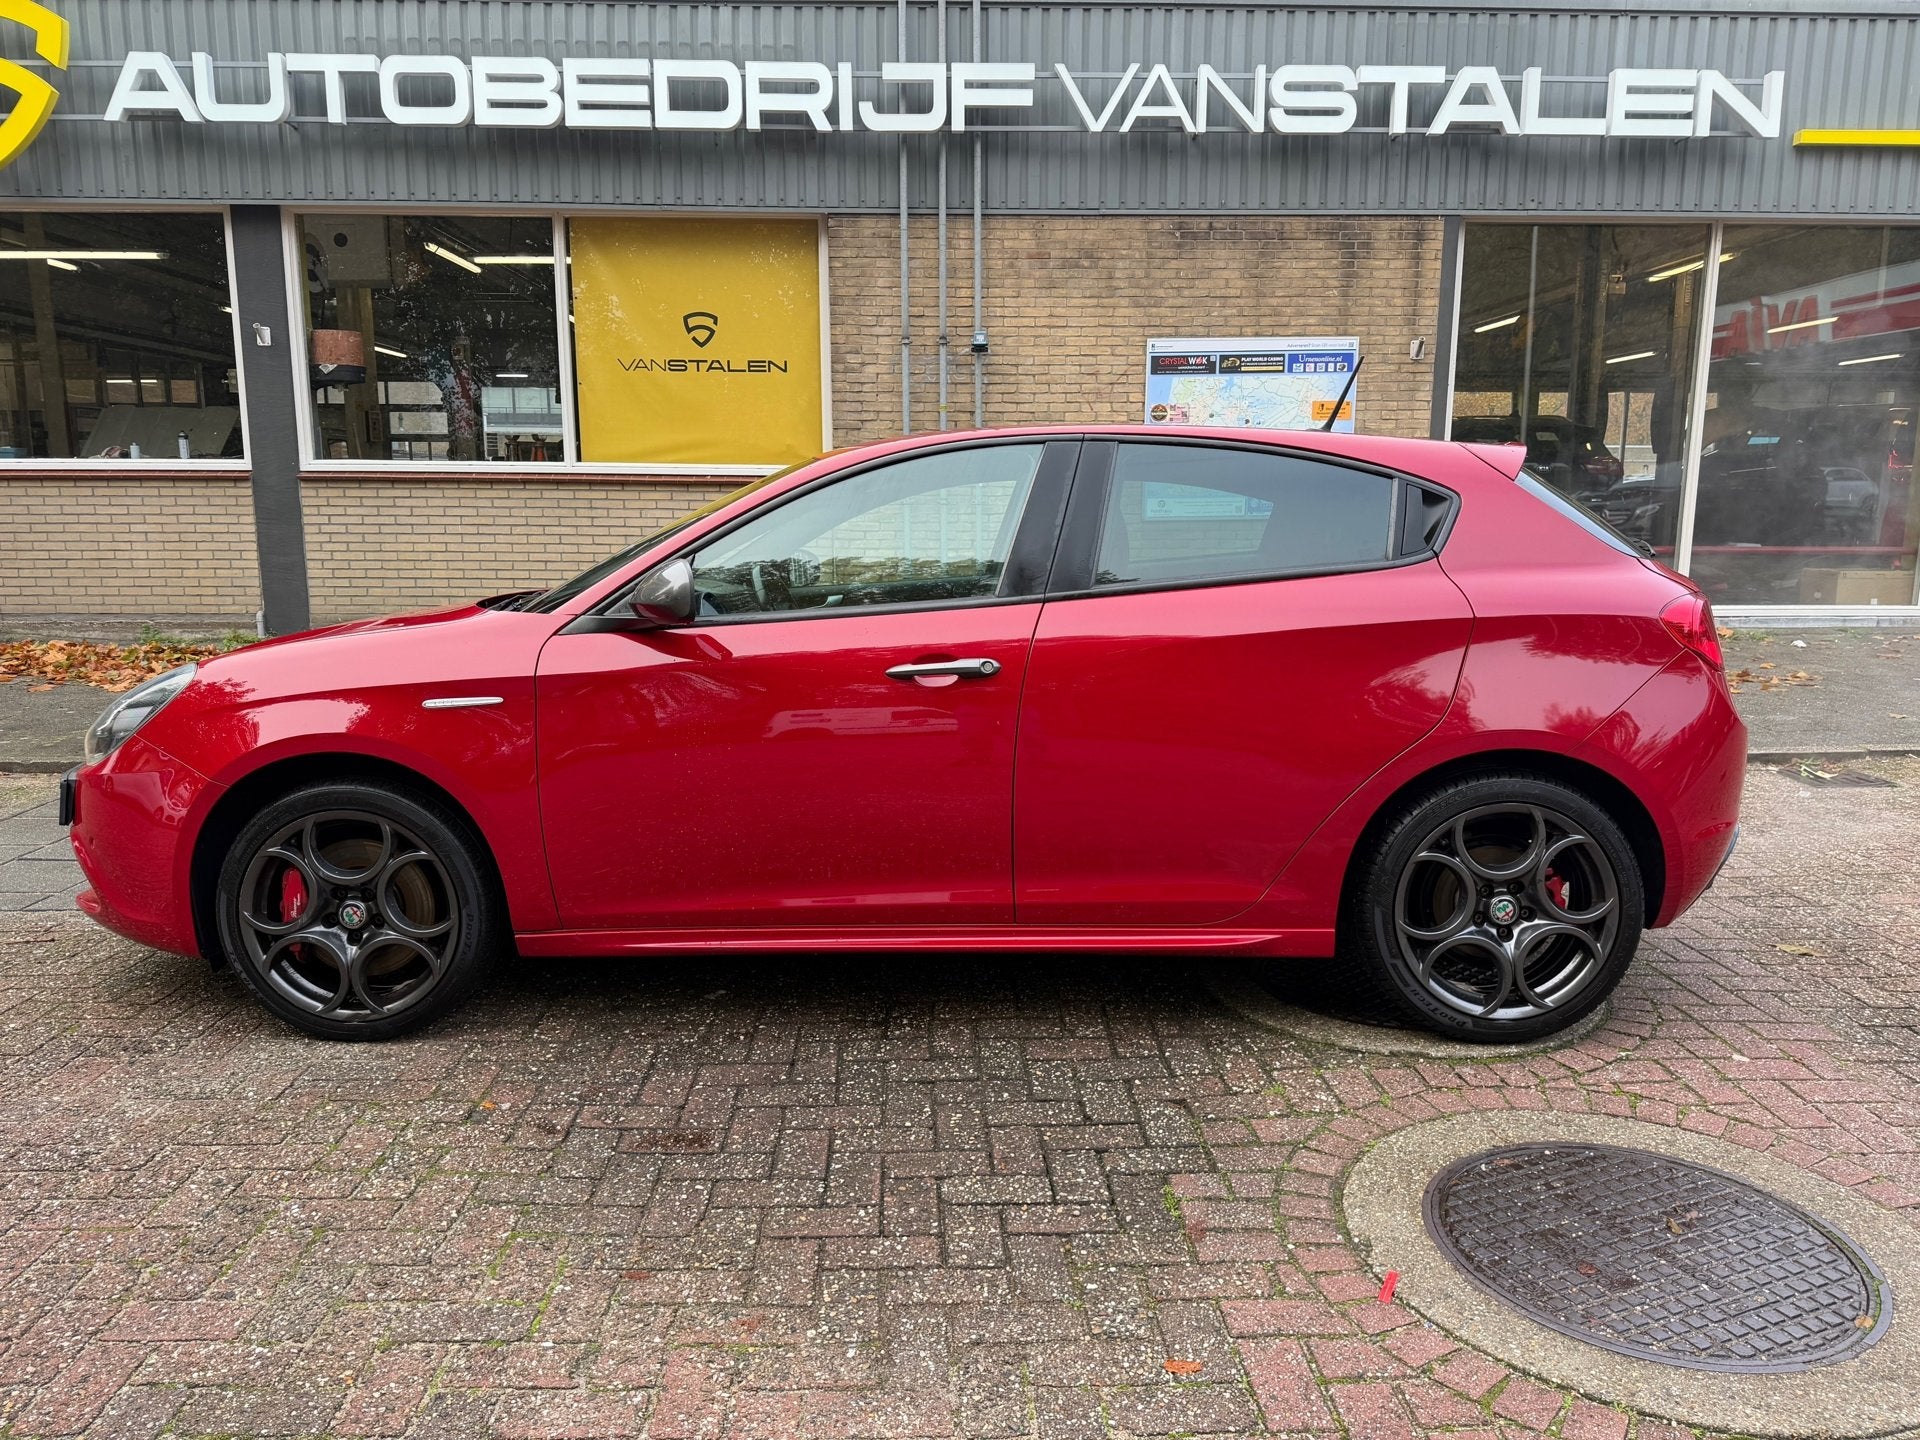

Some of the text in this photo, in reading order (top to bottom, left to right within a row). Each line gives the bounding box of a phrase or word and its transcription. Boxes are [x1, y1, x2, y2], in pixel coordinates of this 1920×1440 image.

[104, 50, 1785, 138] AUTOBEDRIJF VANSTALEN
[617, 358, 787, 373] VANSTALEN
